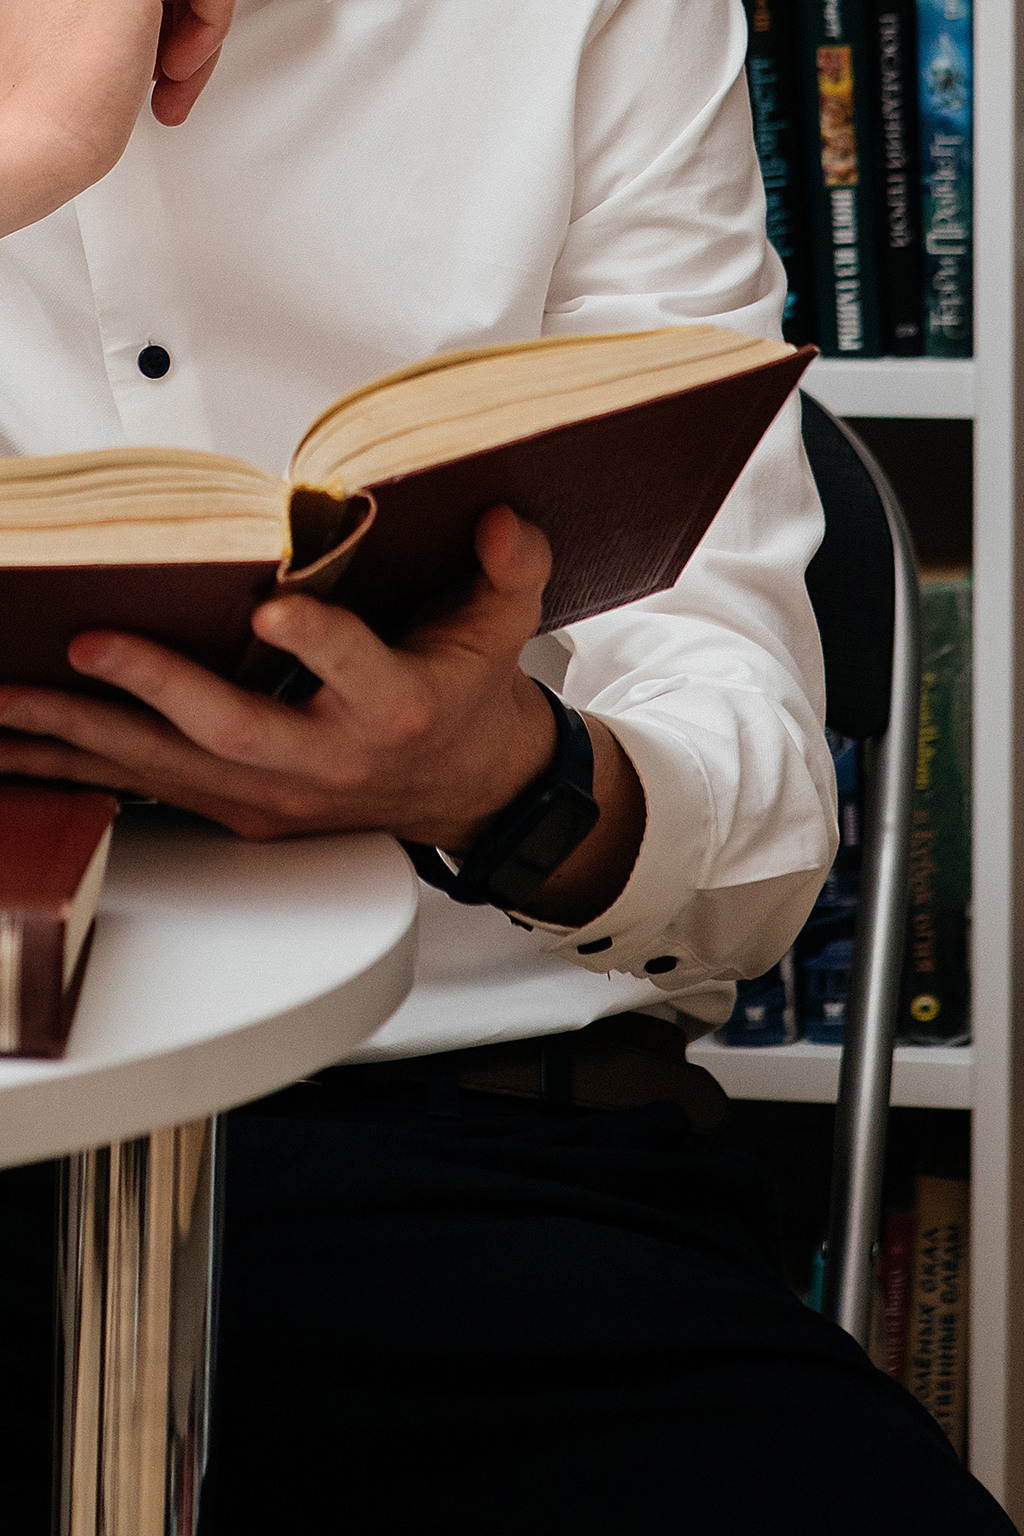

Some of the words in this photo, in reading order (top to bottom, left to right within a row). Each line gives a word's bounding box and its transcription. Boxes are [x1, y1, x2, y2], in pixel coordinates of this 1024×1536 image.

[879, 13, 912, 169] ПОСЛЕДНИЙ
[830, 189, 857, 245] НОГИ
[887, 173, 917, 248] ГЕРОЙ
[834, 247, 860, 277] ИЗ
[835, 279, 864, 351] ГЛИНЫ
[918, 1226, 940, 1294] СКАЛ
[939, 1223, 963, 1305] СЛЕДЫ
